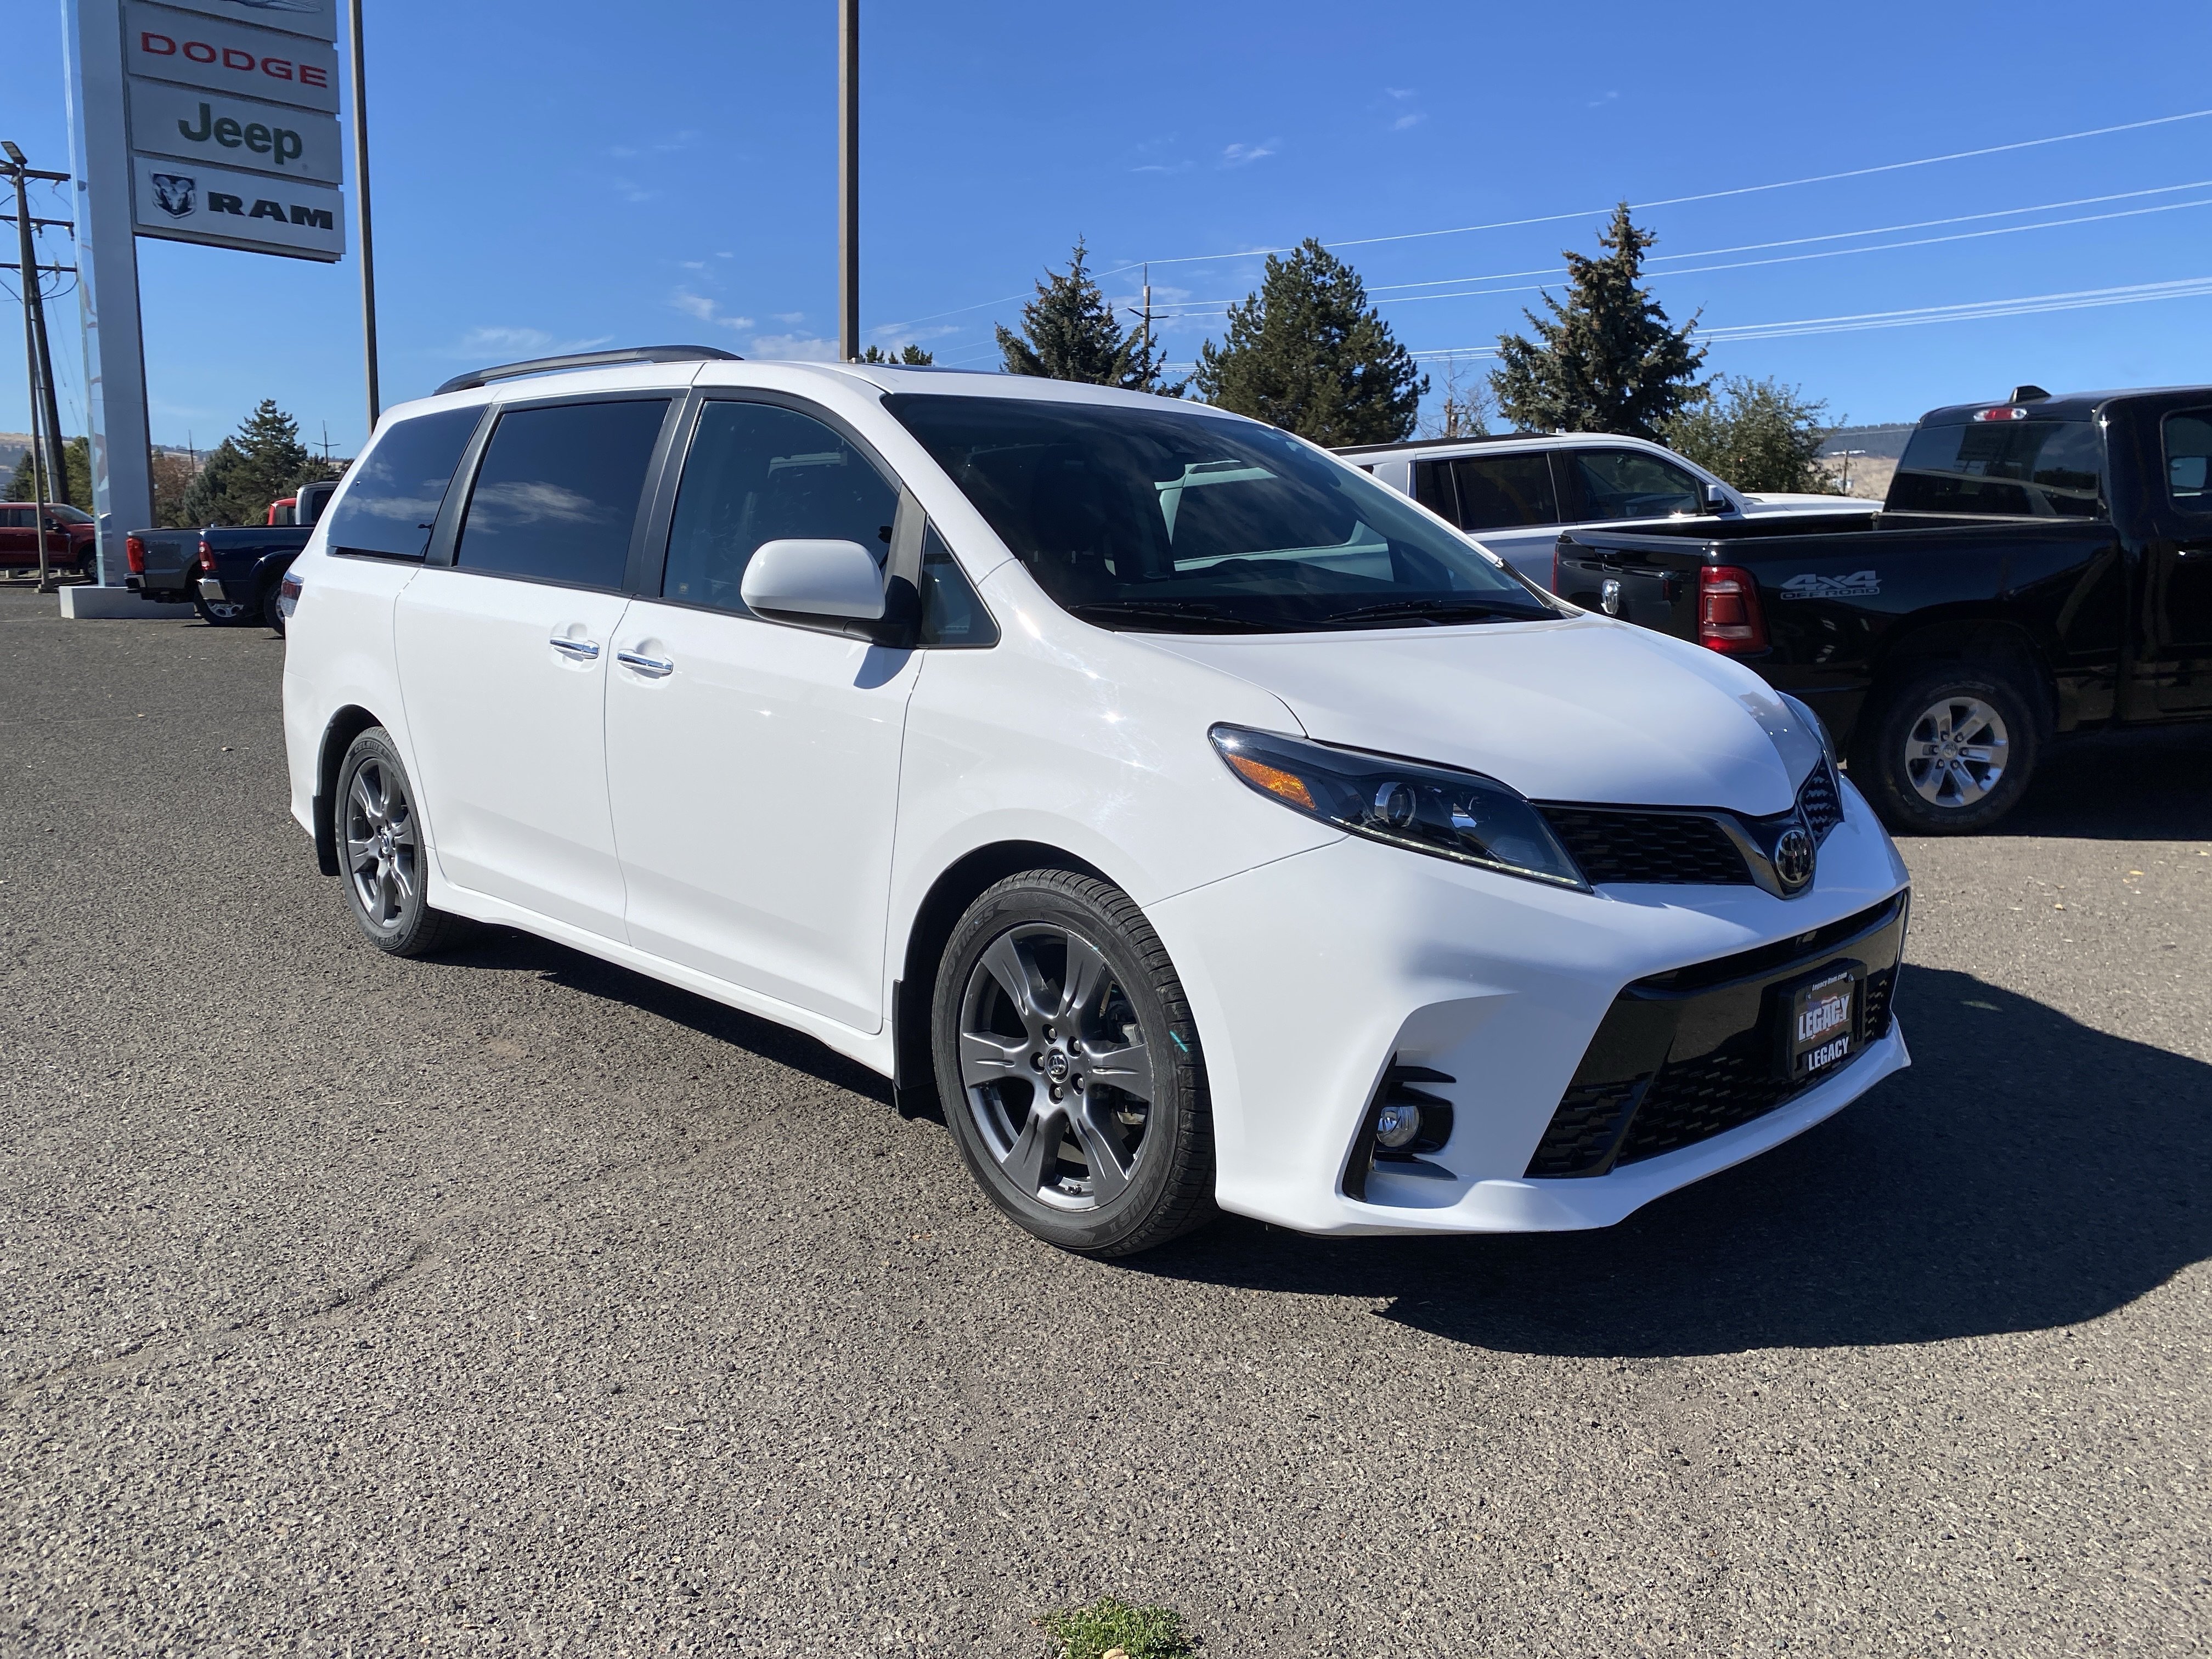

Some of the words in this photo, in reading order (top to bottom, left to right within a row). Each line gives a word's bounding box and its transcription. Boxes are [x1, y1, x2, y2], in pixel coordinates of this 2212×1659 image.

[142, 32, 327, 88] DODGE
[178, 103, 302, 164] Jeep
[208, 191, 334, 230] RAM
[1825, 588, 1878, 596] ROAD
[1798, 995, 1850, 1041] LEGACY
[1808, 1036, 1850, 1071] LEGACY
